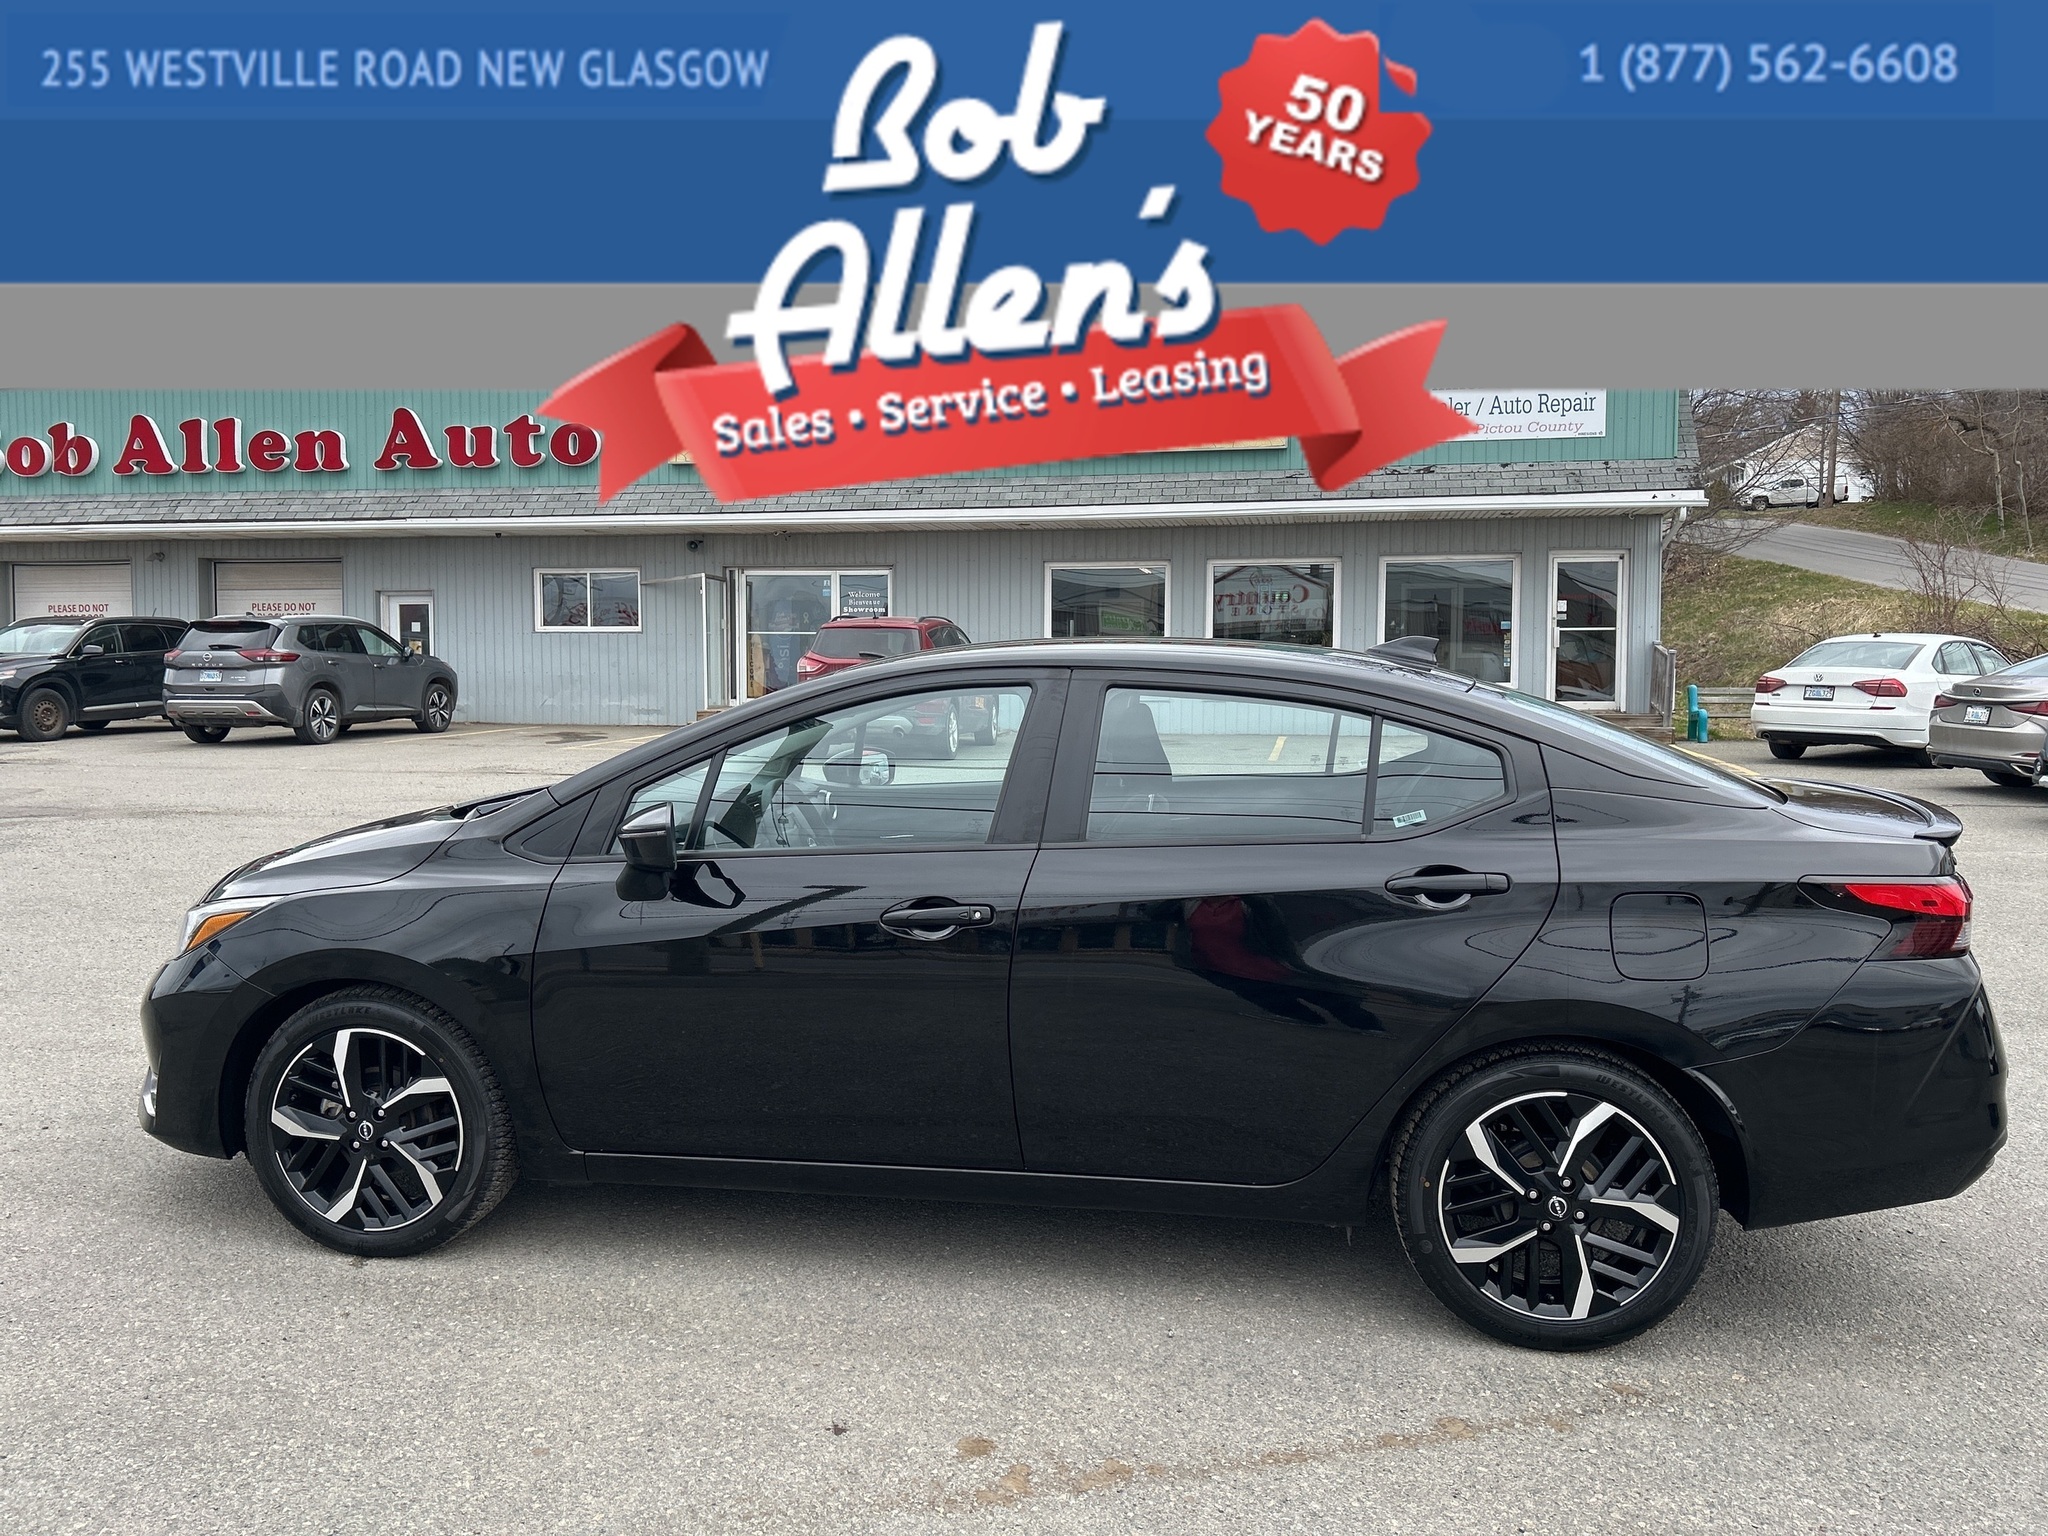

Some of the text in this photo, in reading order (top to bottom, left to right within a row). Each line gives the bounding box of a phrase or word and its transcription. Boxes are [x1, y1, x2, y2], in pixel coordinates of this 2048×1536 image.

[1488, 395, 1533, 416] Auto
[1537, 392, 1597, 417] Repair
[1476, 421, 1584, 435] Pictou County
[112, 414, 349, 476] Allen
[373, 407, 603, 470] Auto
[48, 603, 109, 613] PLEASE DO NOT
[251, 602, 316, 612] PLEASE DO NOT
